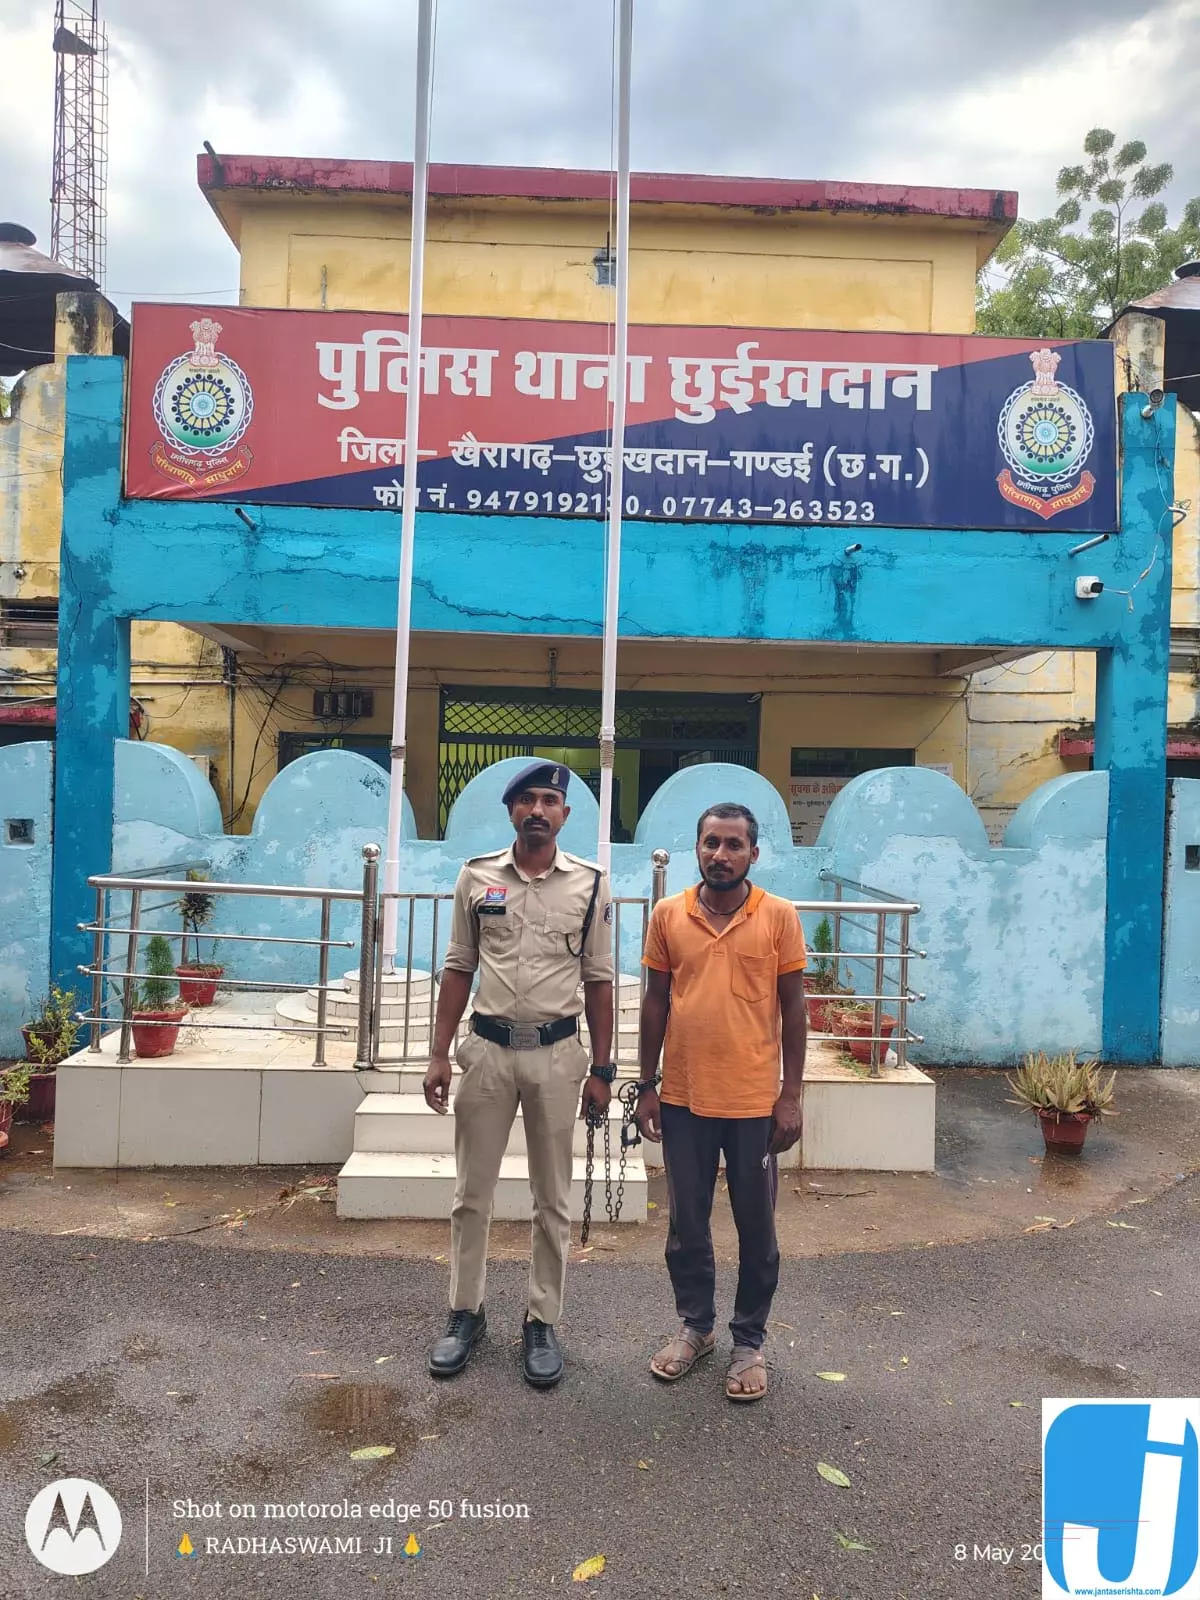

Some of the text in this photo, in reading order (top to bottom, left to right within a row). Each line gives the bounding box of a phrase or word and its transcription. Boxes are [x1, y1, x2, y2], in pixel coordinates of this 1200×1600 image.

[315, 330, 939, 424] पुलिस थाना छुईखदान
[822, 446, 930, 487] (छ.ग.)
[662, 496, 875, 522] 07743-263523
